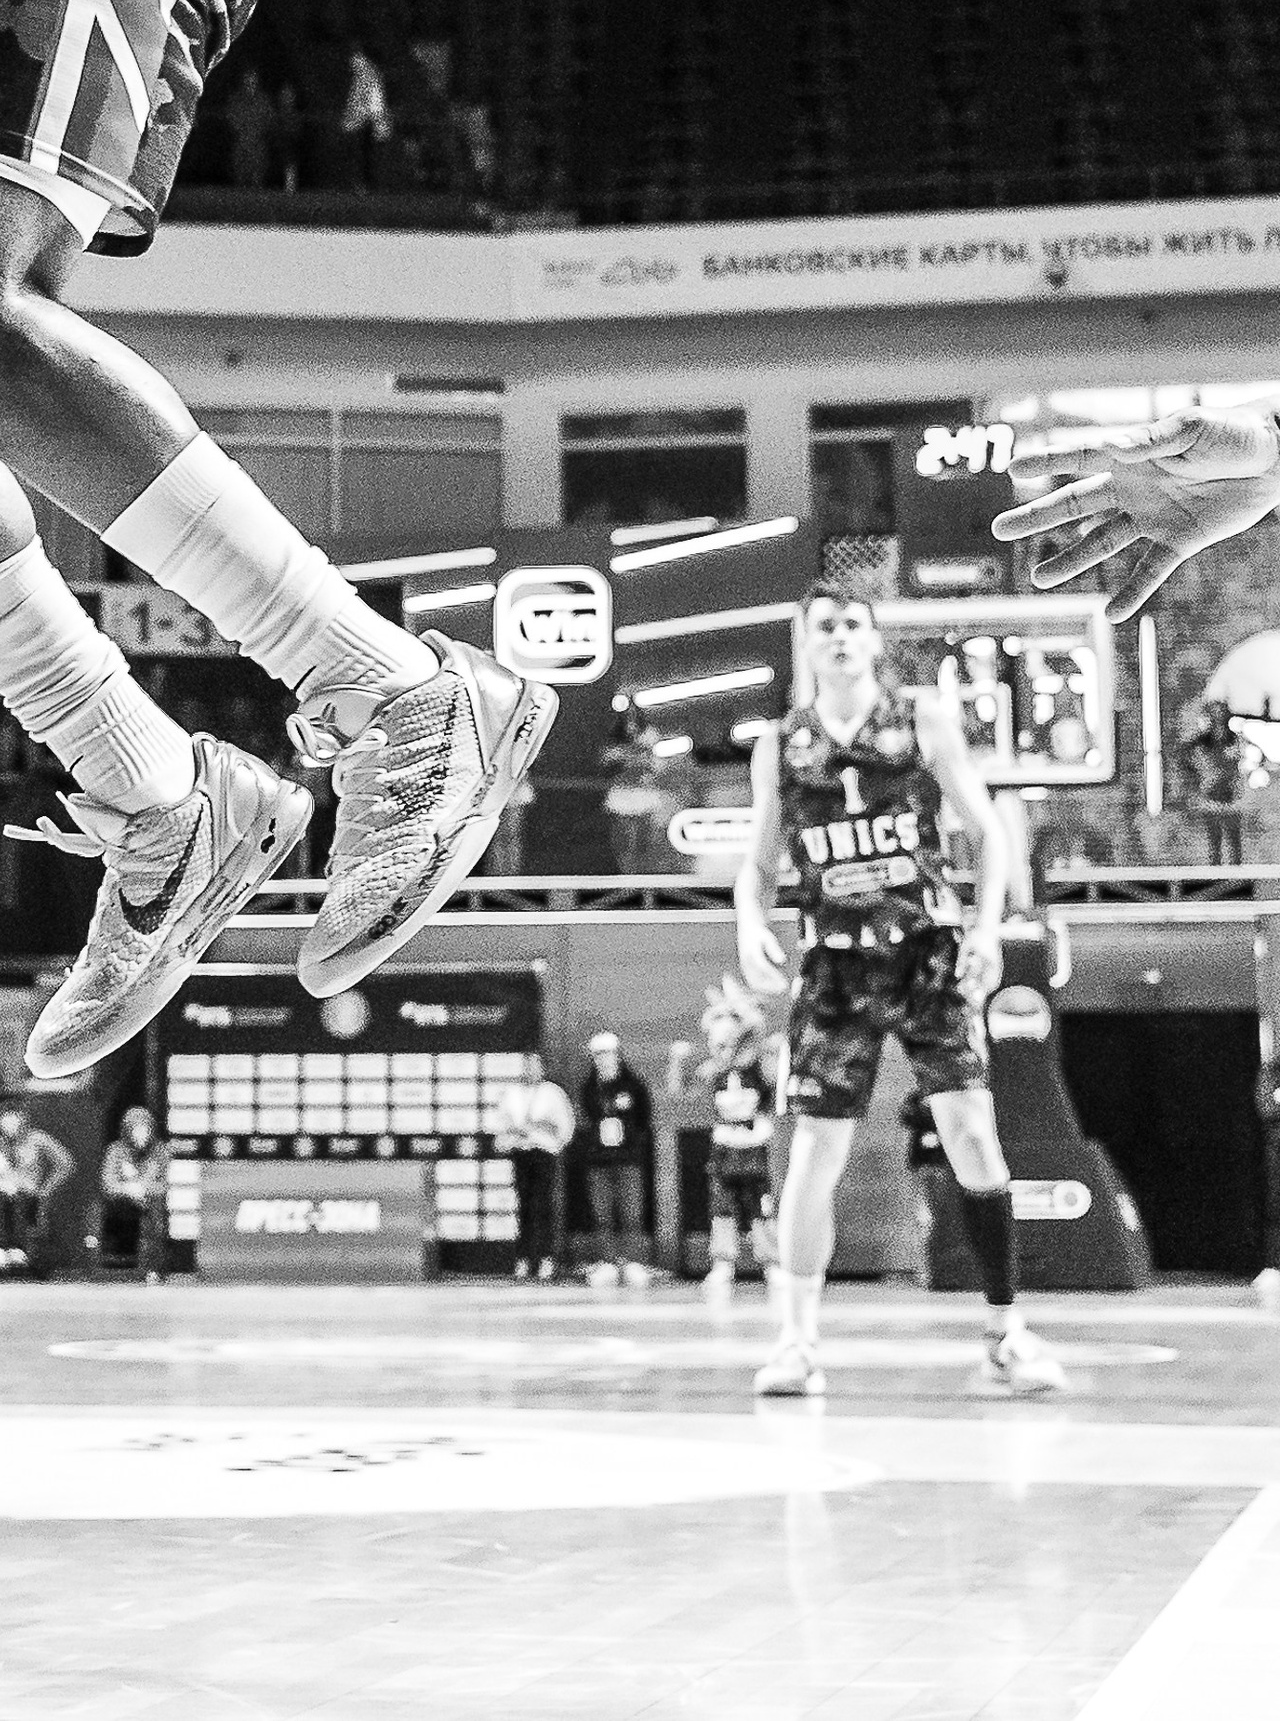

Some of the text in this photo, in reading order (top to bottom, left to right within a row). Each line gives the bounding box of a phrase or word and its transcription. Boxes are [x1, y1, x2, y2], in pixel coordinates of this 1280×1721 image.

[703, 242, 910, 277] БАНКОВСКИЕ
[839, 766, 868, 815] 1
[801, 812, 920, 864] UNICS
